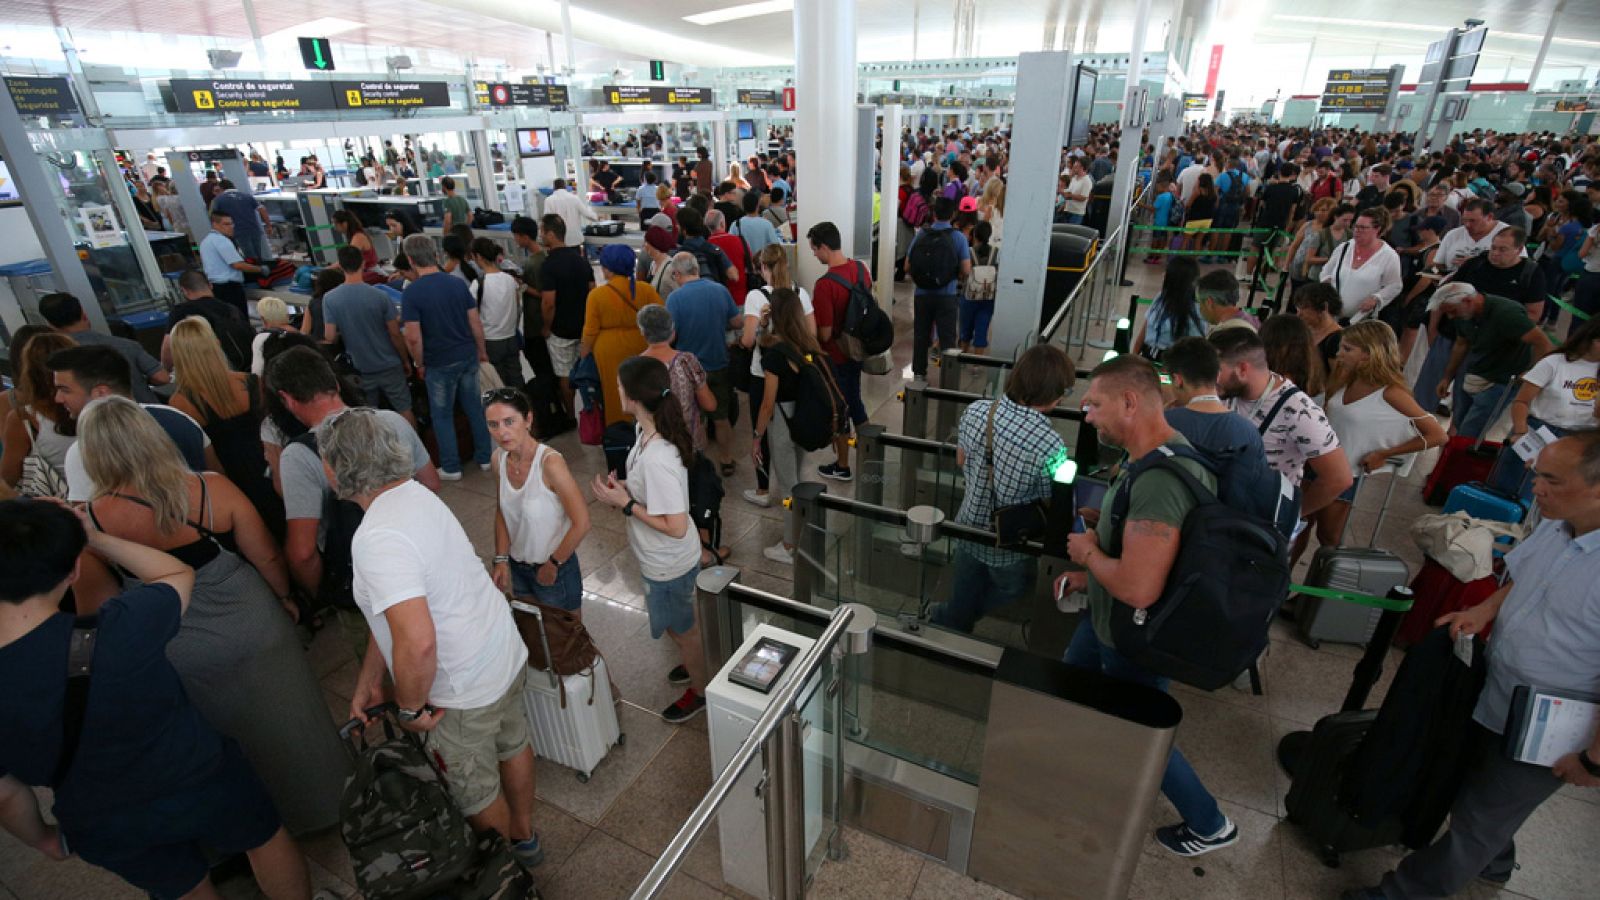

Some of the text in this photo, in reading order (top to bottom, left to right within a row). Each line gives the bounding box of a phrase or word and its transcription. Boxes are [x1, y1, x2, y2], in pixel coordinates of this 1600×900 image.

[213, 82, 294, 91] Control de seguretat
[360, 82, 383, 90] Control
[218, 99, 300, 108] Control de seguridad
[364, 97, 386, 105] Control
